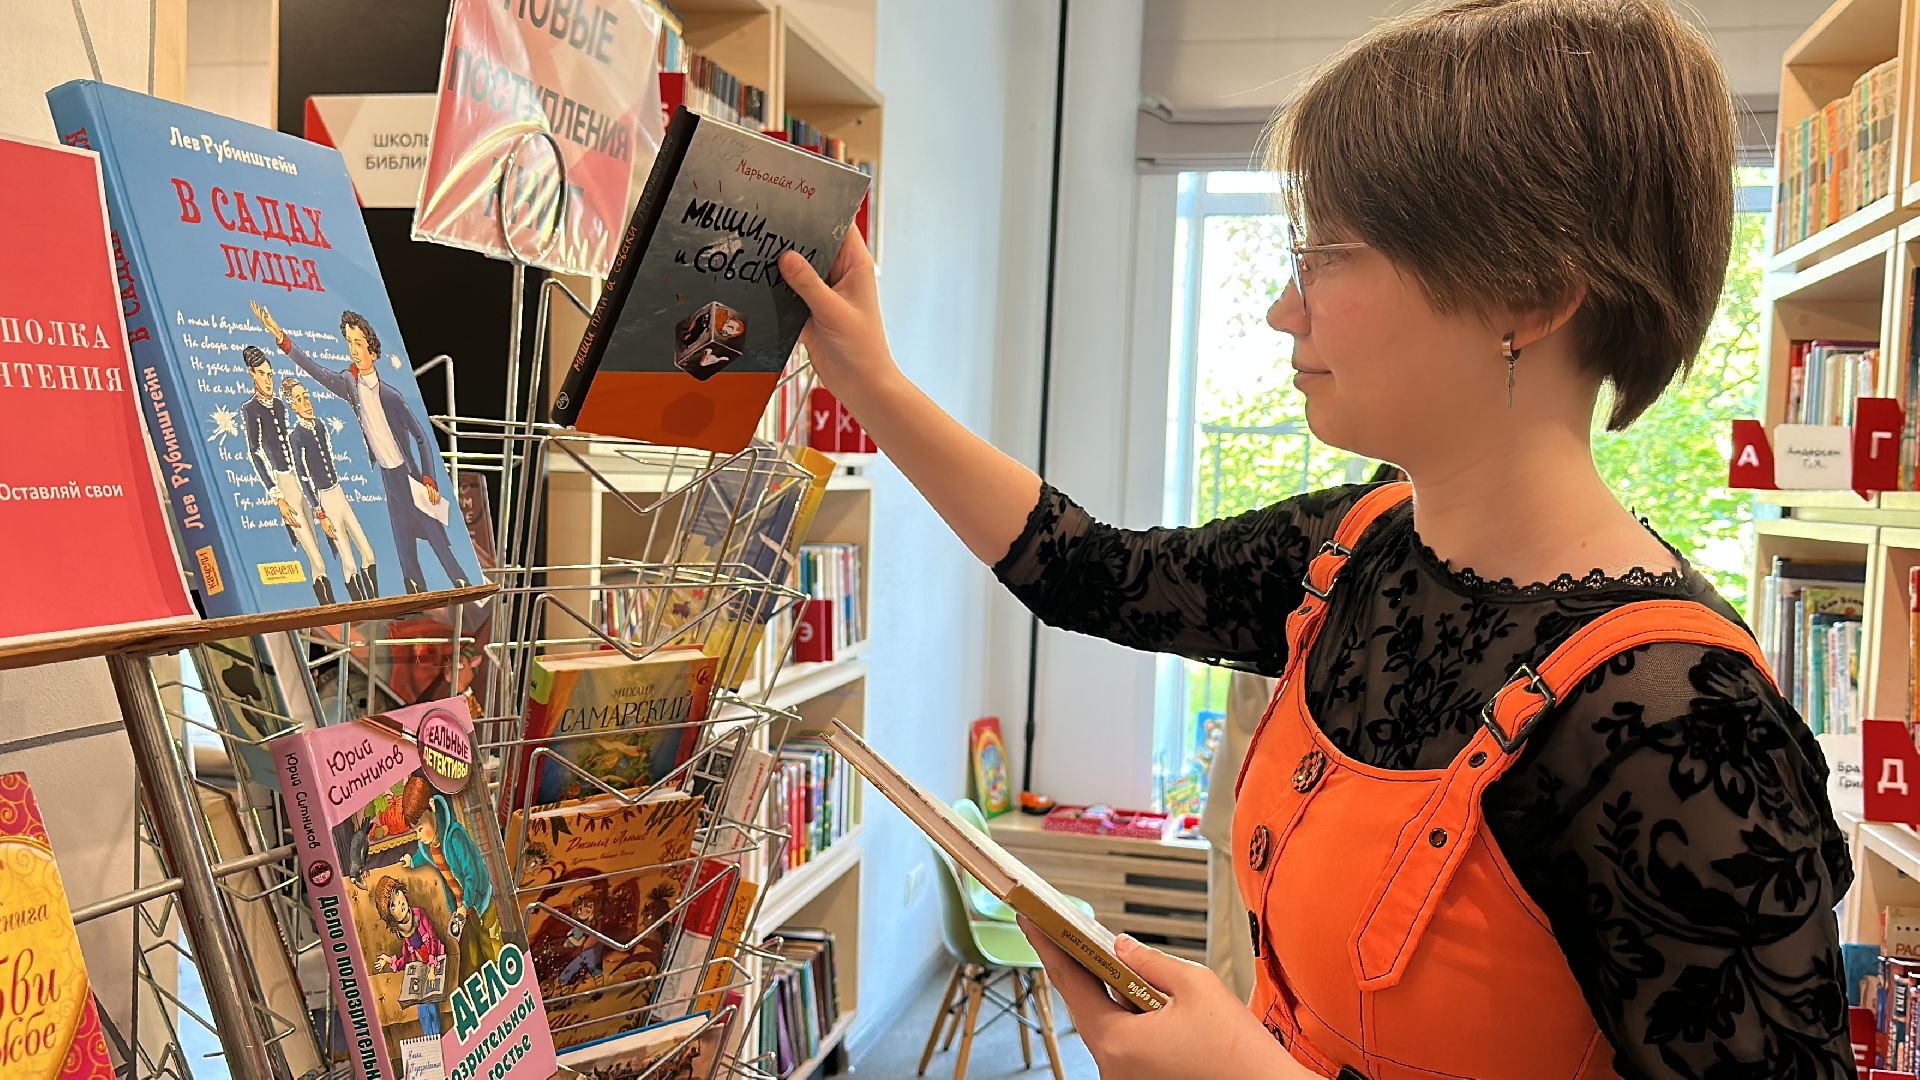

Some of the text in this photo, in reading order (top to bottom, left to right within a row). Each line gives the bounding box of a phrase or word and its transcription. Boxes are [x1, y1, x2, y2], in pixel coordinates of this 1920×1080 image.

[447, 46, 631, 162] ПОСТУПЛЕНИЯ
[170, 126, 298, 176] Лев Рубинштейн
[736, 158, 817, 199] Марьолейн Хоф
[170, 177, 333, 250] В САДАХ
[220, 243, 325, 292] ЛИЦЕЯ
[0, 317, 111, 349] ПОЛКА
[144, 367, 205, 529] Лев Рубинштейн
[1736, 444, 1760, 468] А
[1869, 431, 1893, 460] Г
[0, 481, 124, 501] Оставляй свои
[560, 690, 693, 733] САМАРСКИЙ
[327, 739, 374, 777] Юрий
[328, 744, 404, 805] Ситников
[1877, 758, 1909, 796] Д
[285, 752, 302, 787] Юрий
[296, 791, 320, 849] Ситников
[450, 944, 525, 1044] ДЕЛО
